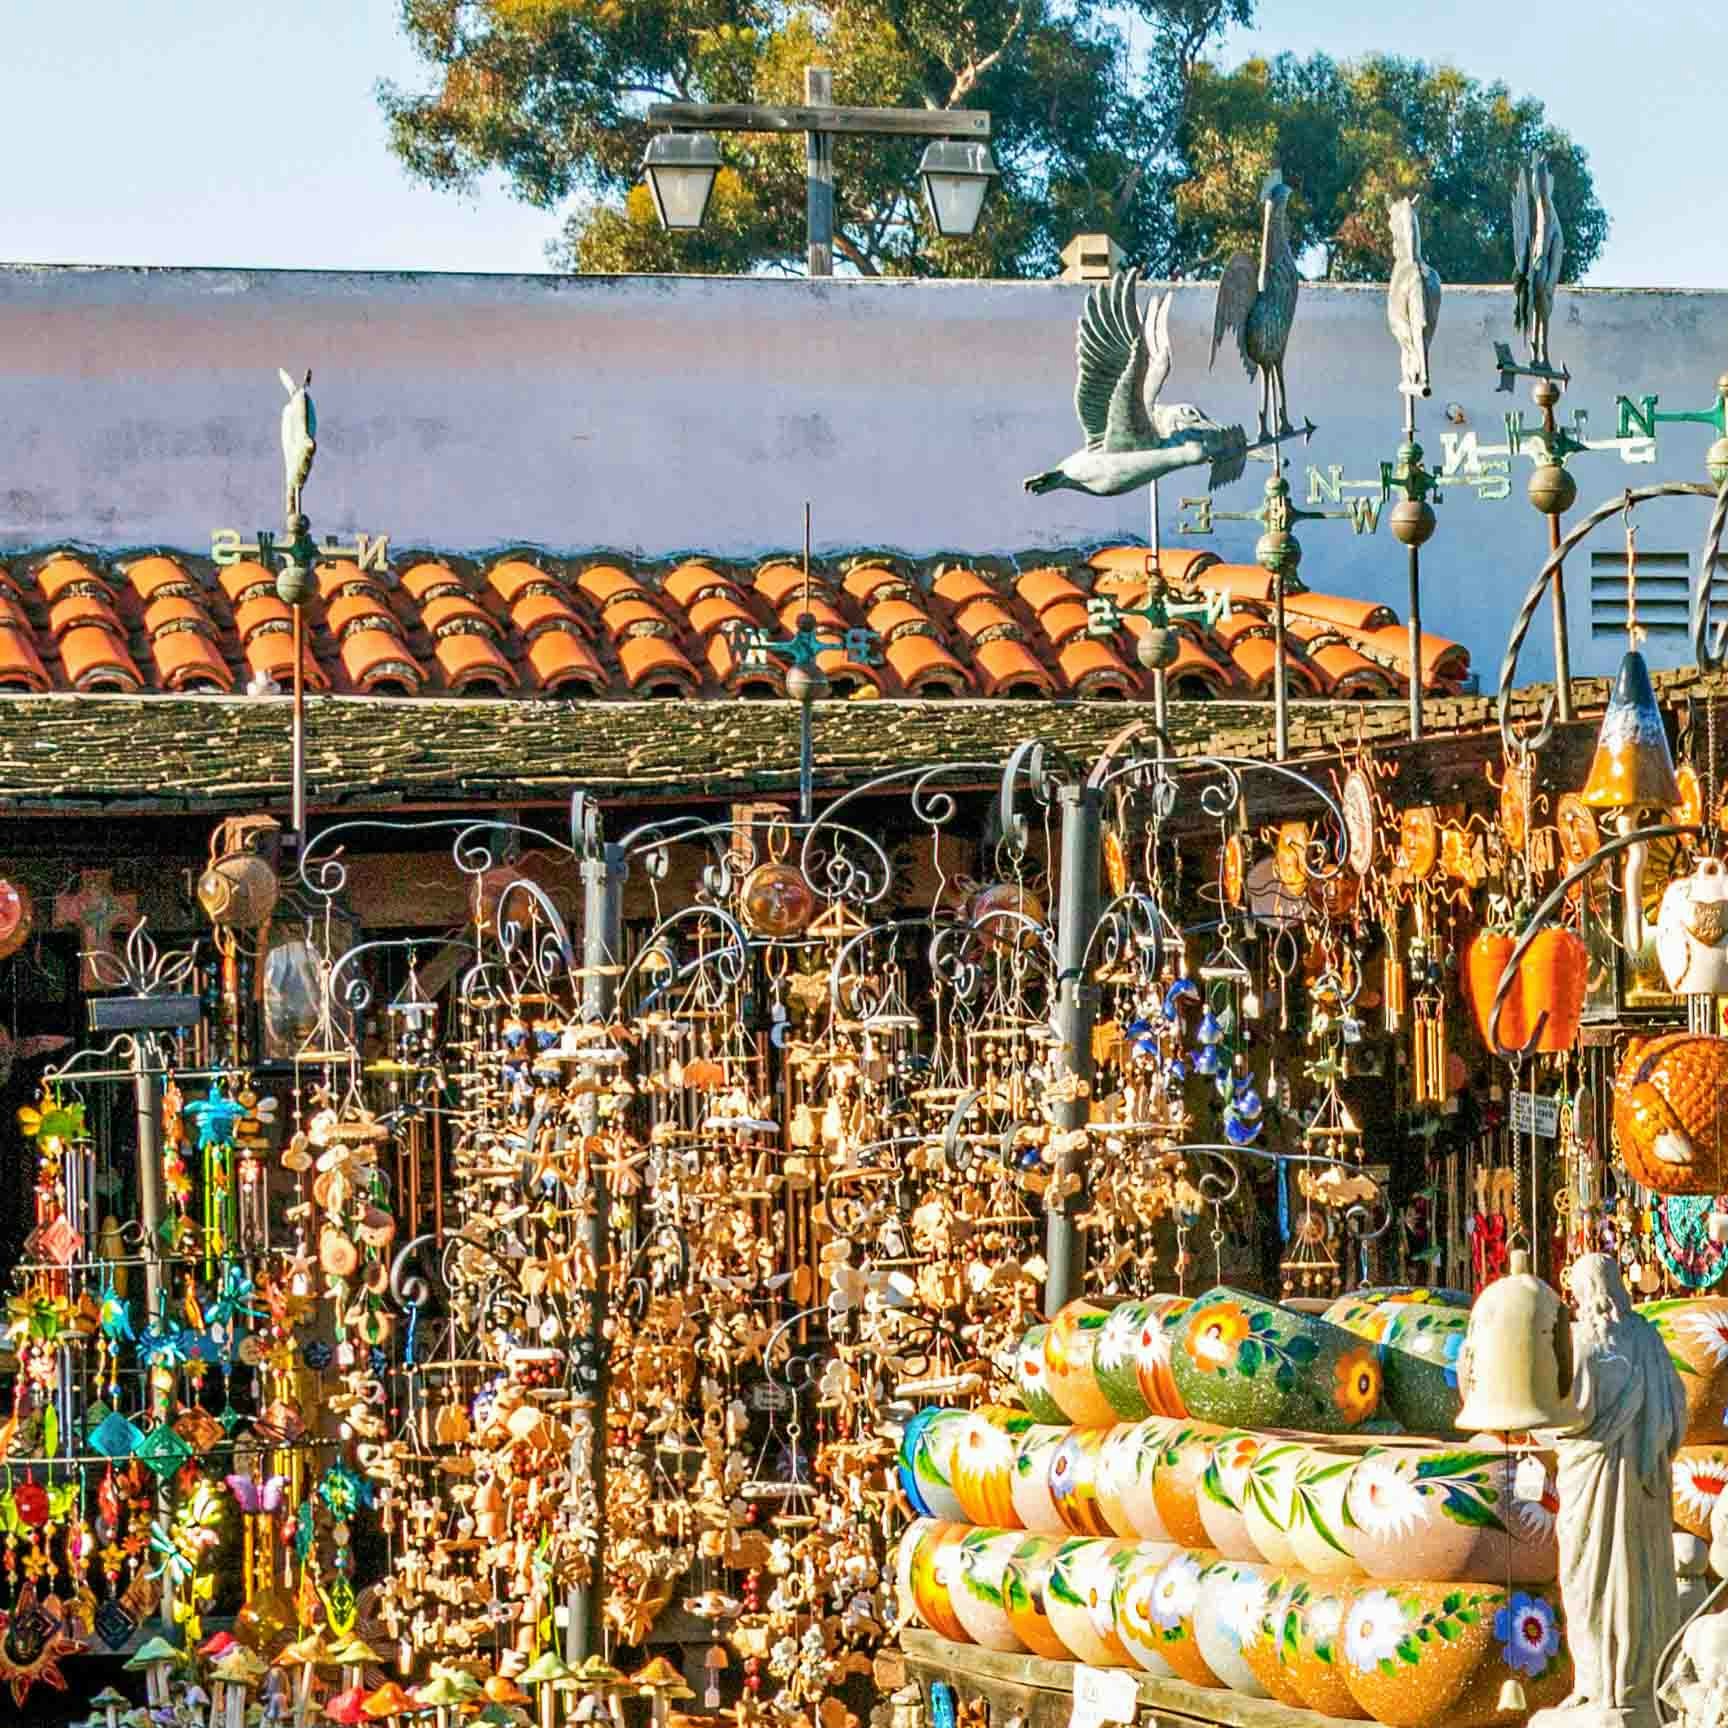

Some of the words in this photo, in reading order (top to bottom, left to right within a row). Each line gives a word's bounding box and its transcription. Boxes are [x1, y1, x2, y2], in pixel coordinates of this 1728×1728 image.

[1616, 394, 1659, 439] N
[1306, 464, 1344, 505] N
[1348, 496, 1383, 534] W
